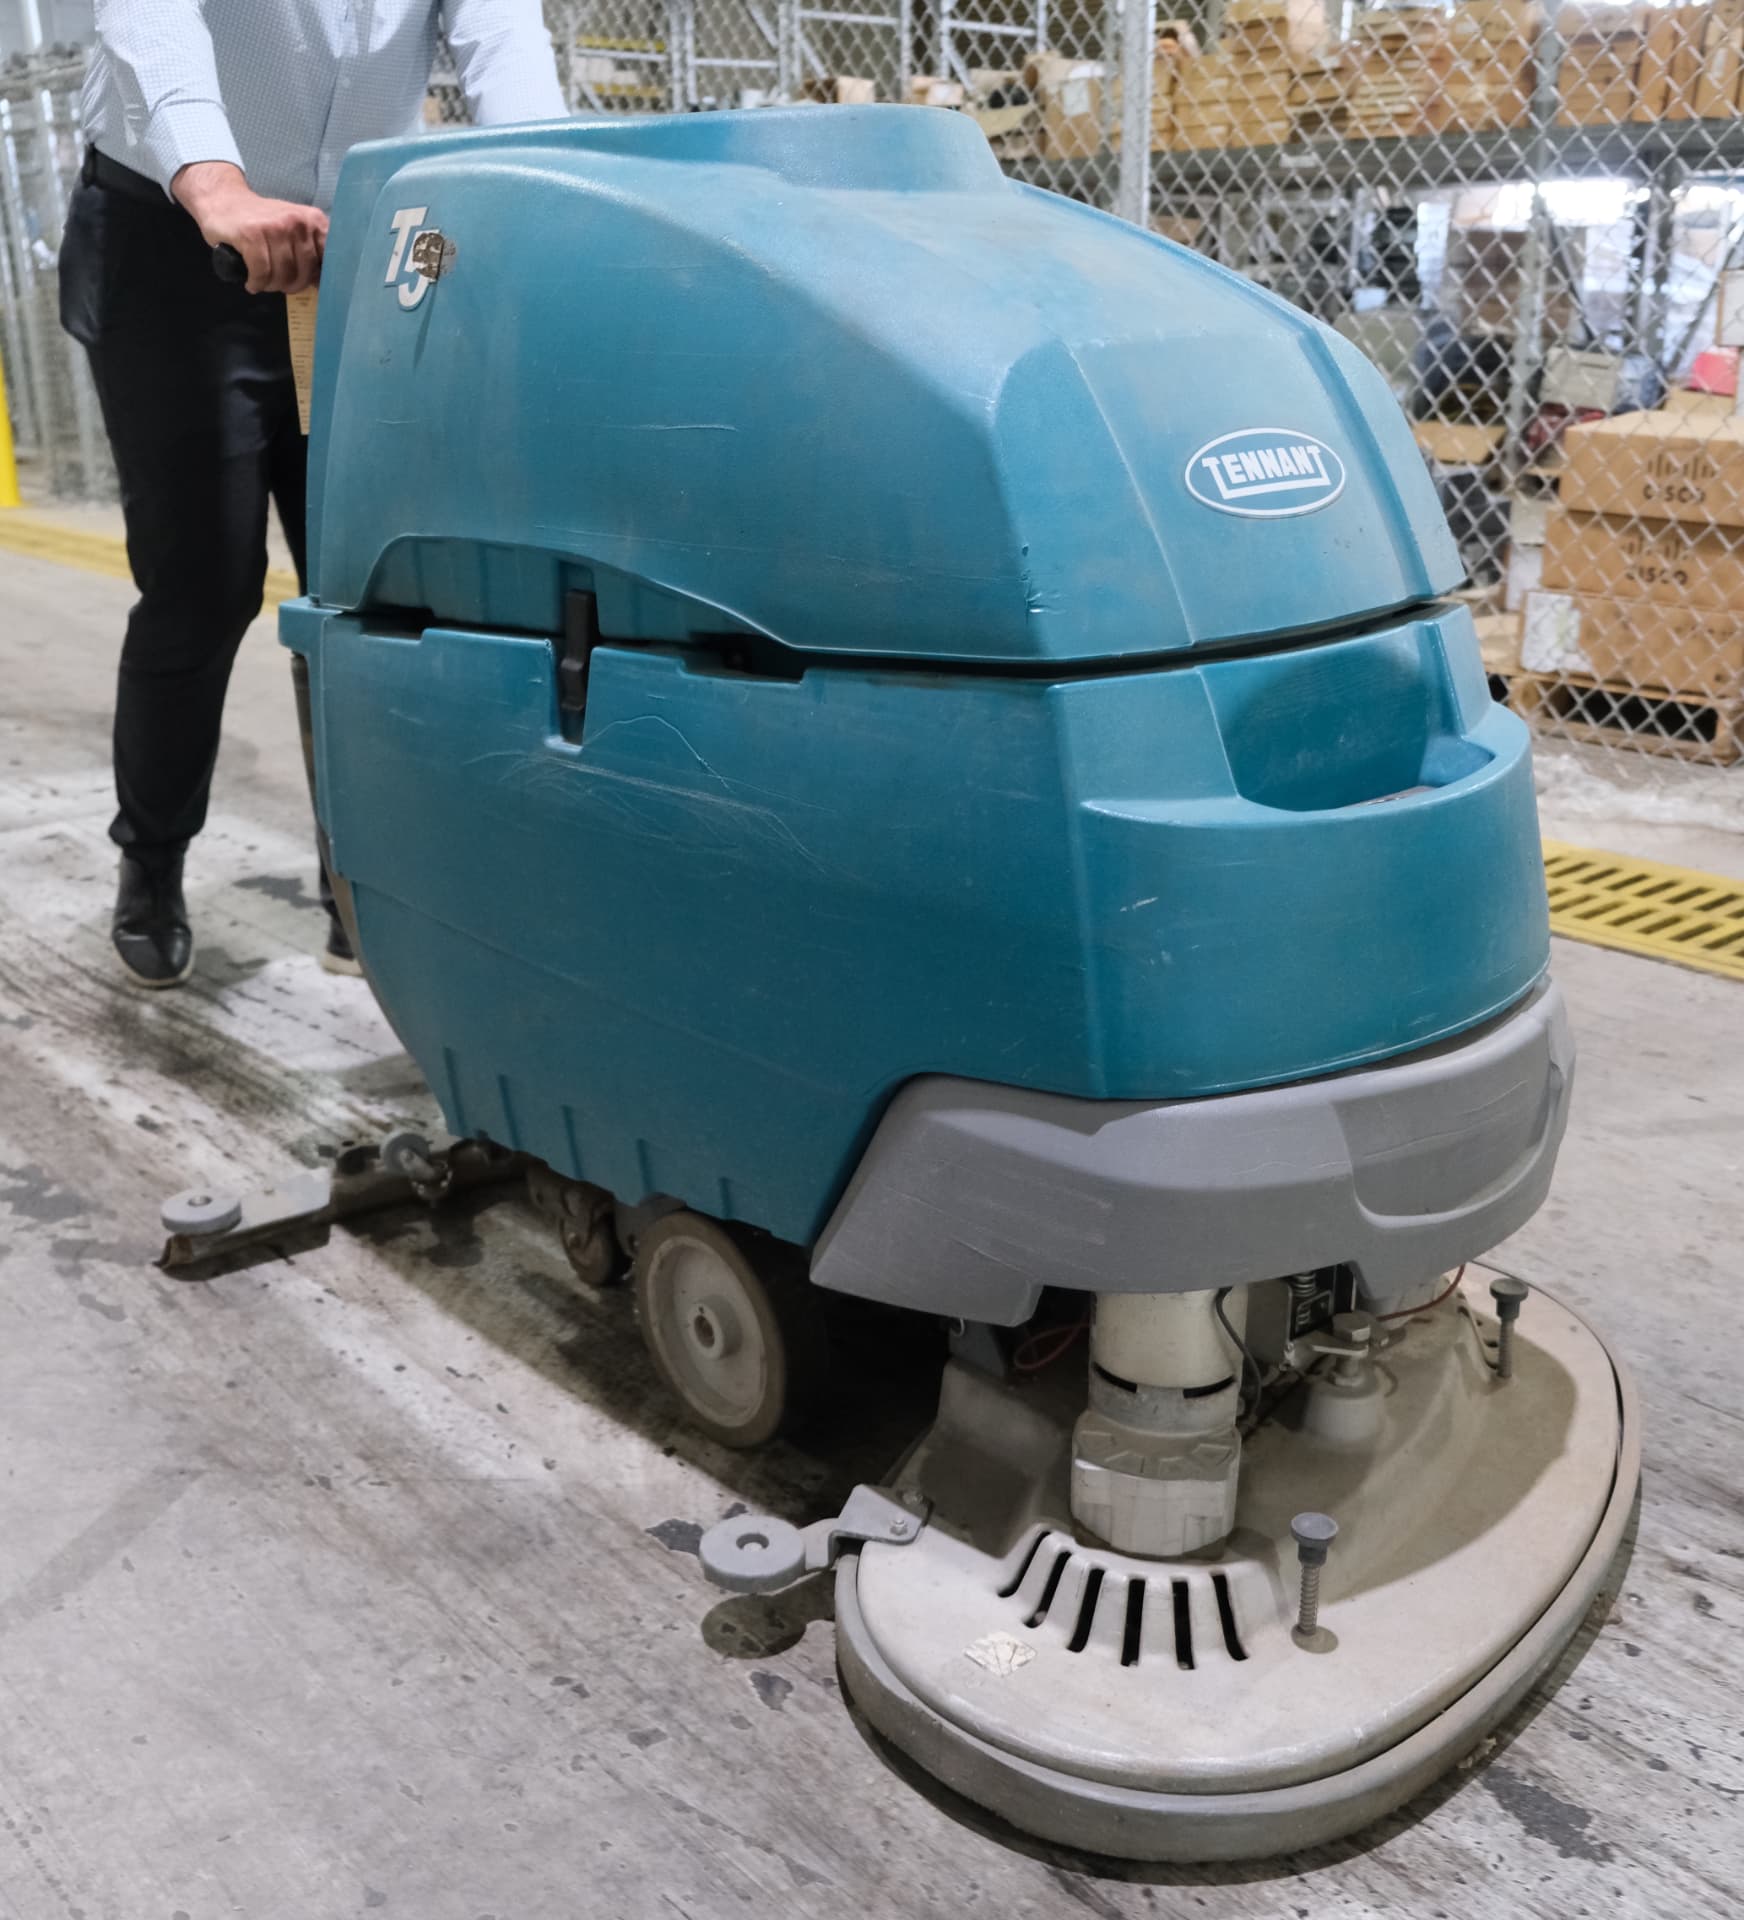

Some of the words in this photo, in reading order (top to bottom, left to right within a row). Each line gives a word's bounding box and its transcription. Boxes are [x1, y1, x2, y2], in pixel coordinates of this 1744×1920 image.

[385, 206, 440, 308] T5
[1202, 446, 1331, 500] TENNANT
[1642, 484, 1706, 503] CSCO
